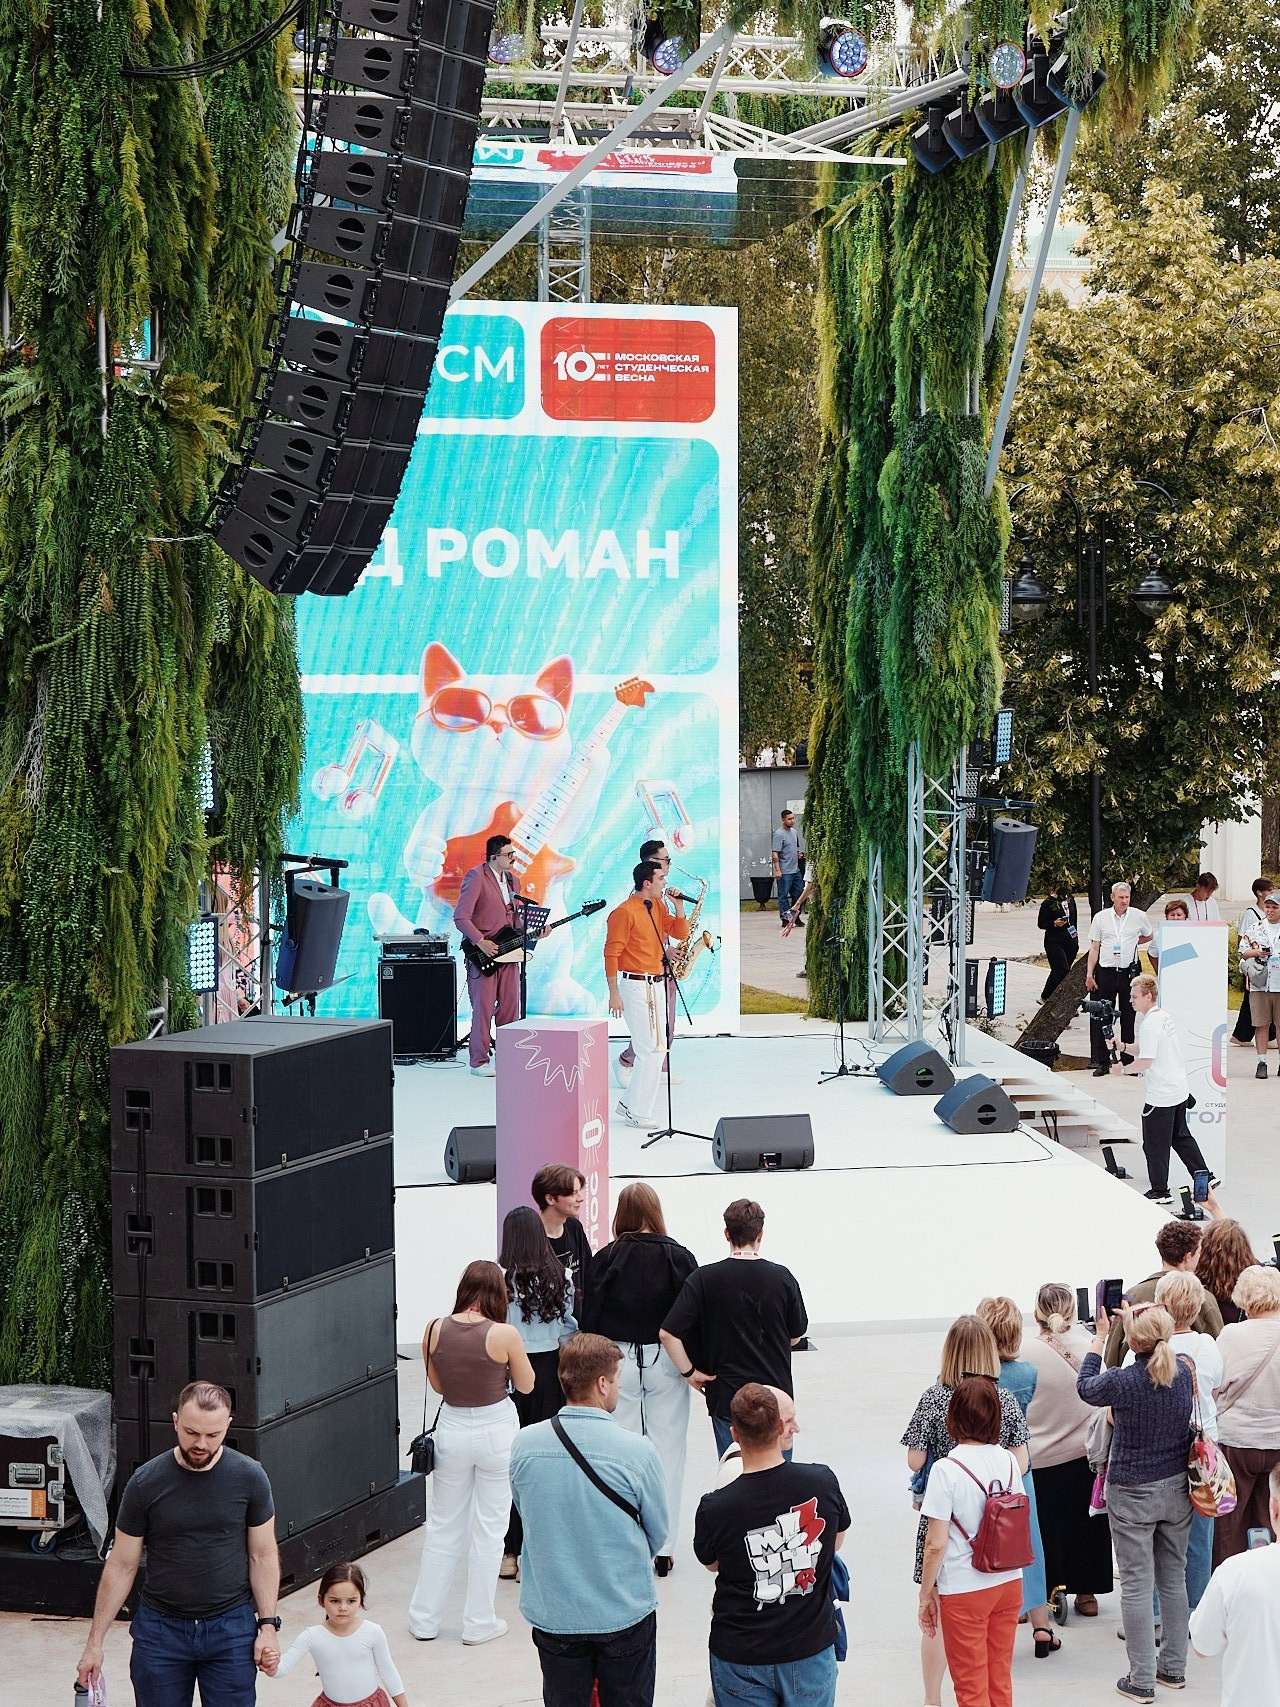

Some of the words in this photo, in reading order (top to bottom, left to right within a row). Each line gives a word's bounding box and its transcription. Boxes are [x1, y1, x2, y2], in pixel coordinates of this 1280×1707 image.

[614, 353, 700, 363] МОСКОВСКАЯ
[614, 363, 710, 373] СТУДЕНЧЕСКАЯ
[614, 374, 656, 382] ВЕСНА
[426, 527, 680, 580] РОМАН
[590, 1170, 599, 1254] ЛОС
